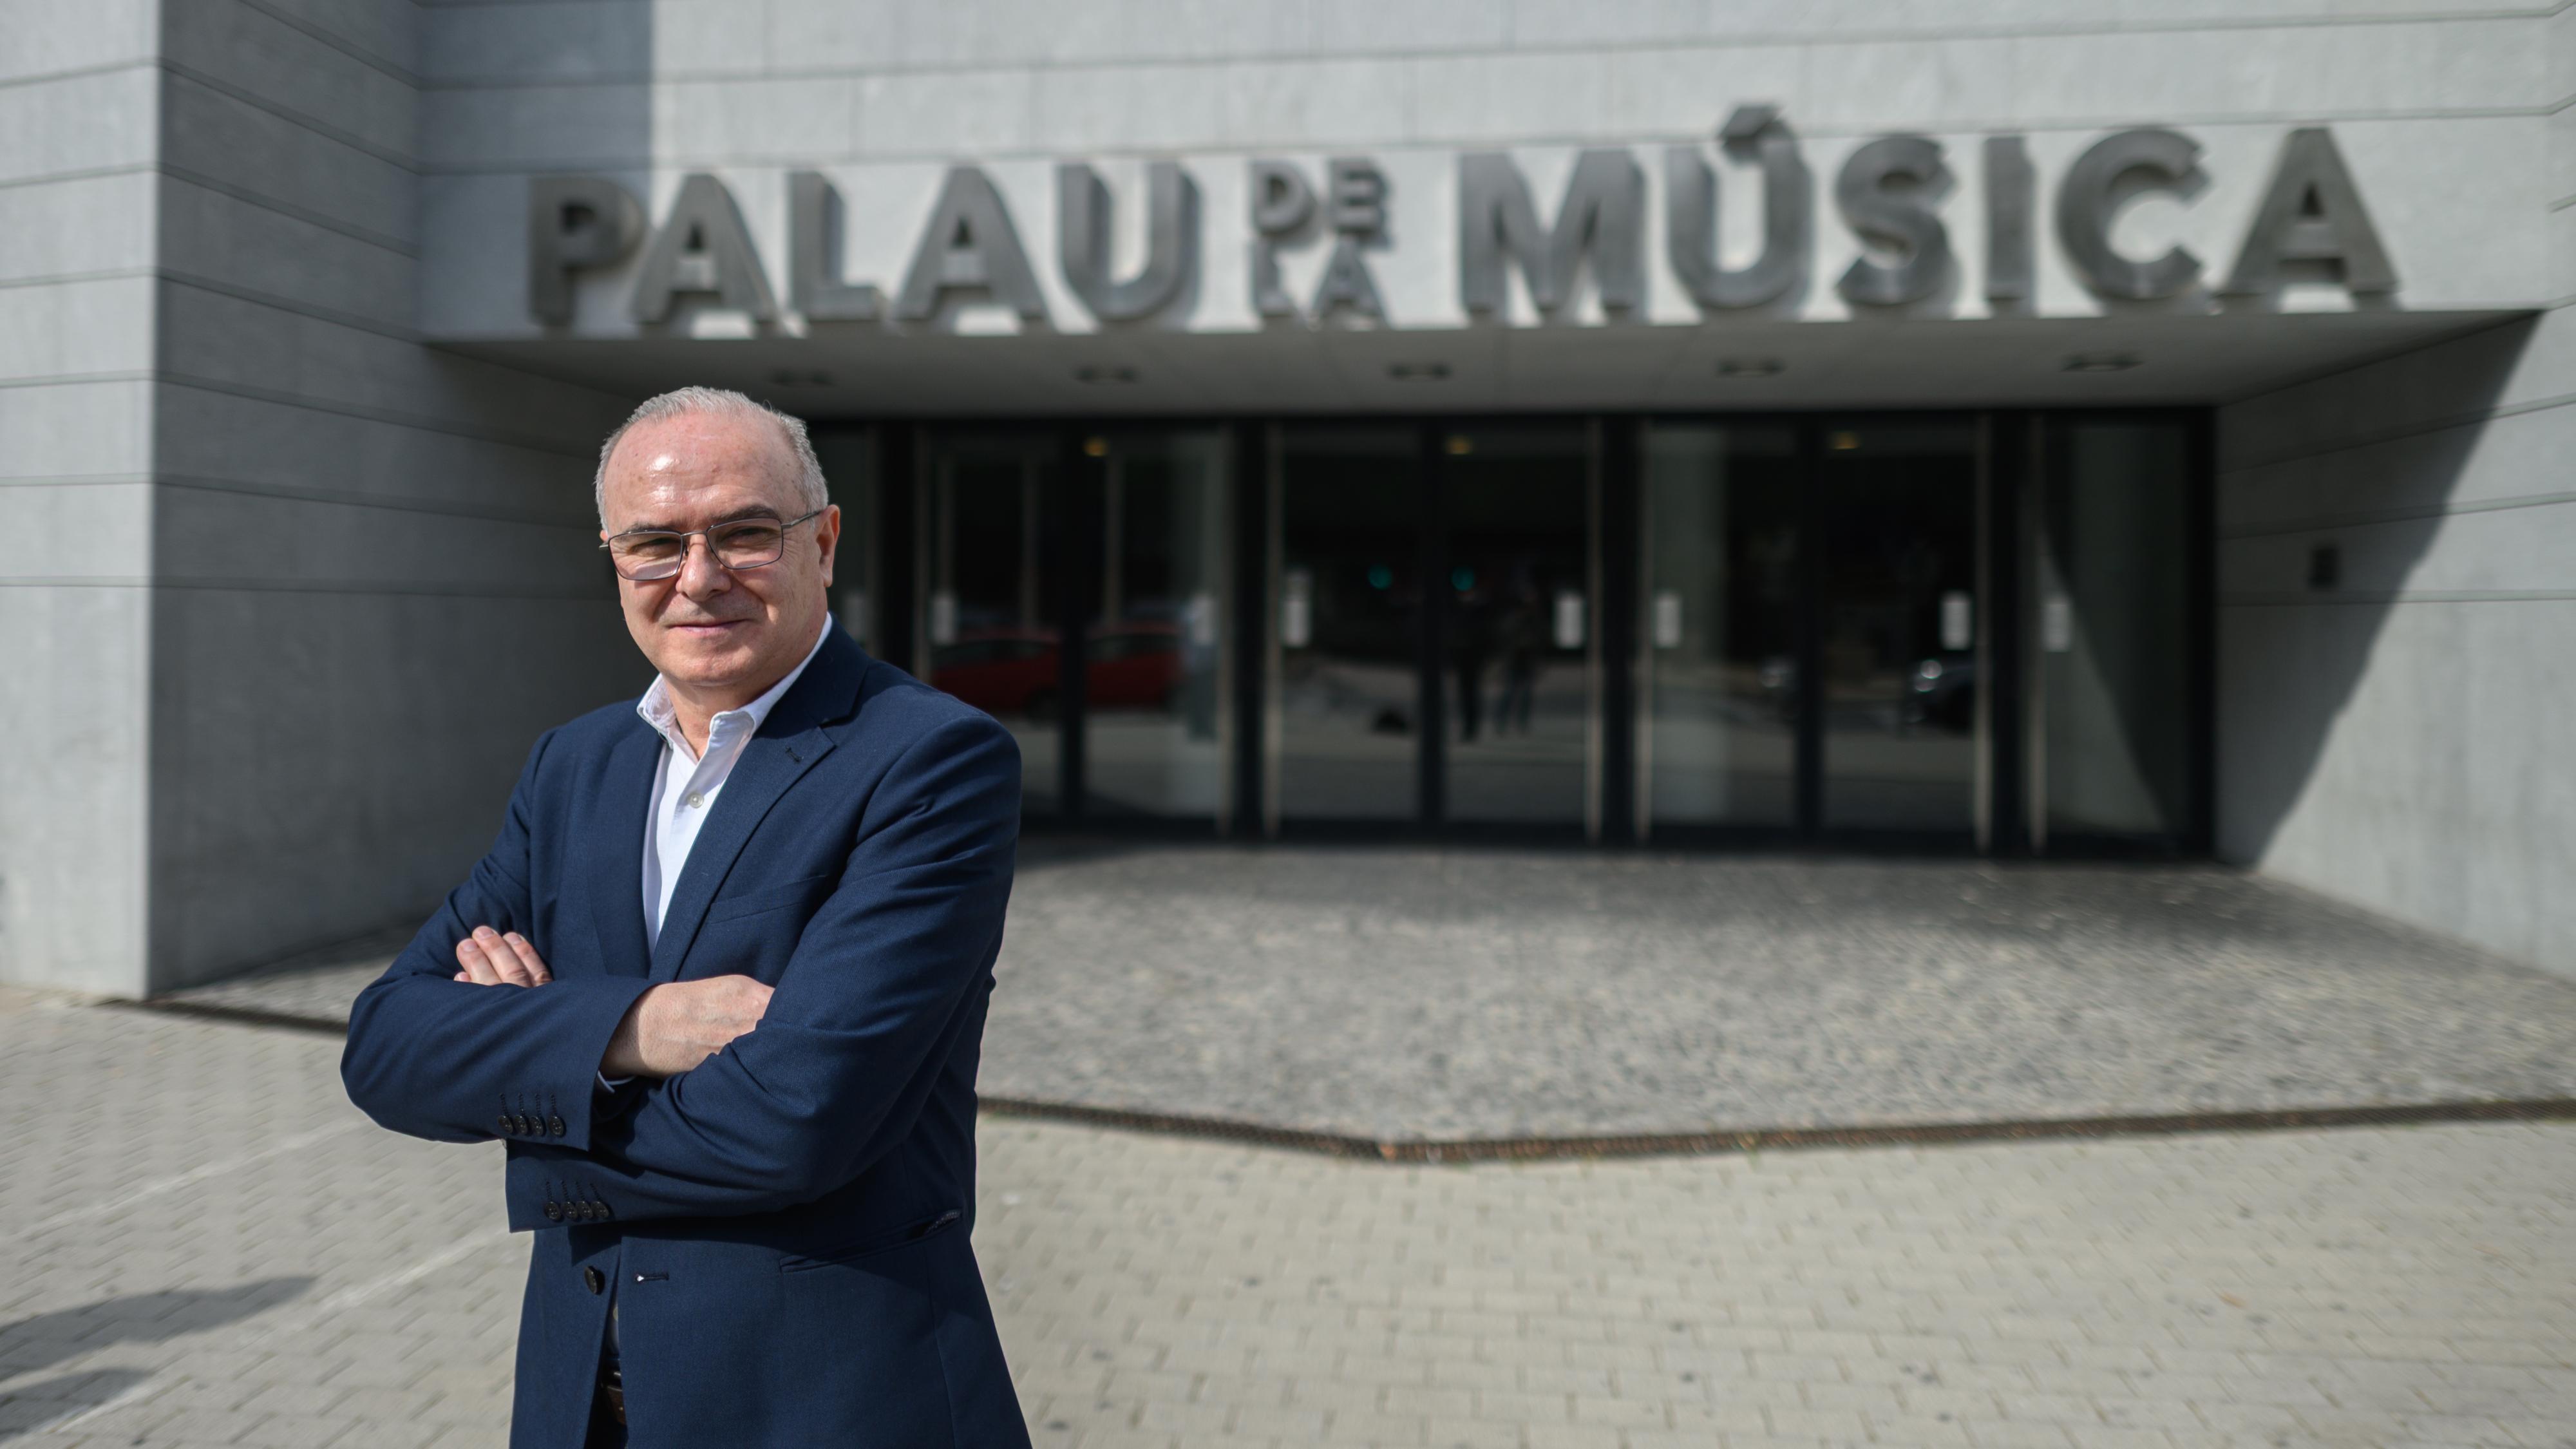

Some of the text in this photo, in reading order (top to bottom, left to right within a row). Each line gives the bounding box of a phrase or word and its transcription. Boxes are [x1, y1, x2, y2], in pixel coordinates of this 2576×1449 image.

[528, 103, 2397, 327] PALAU DE LA MÚSICA
